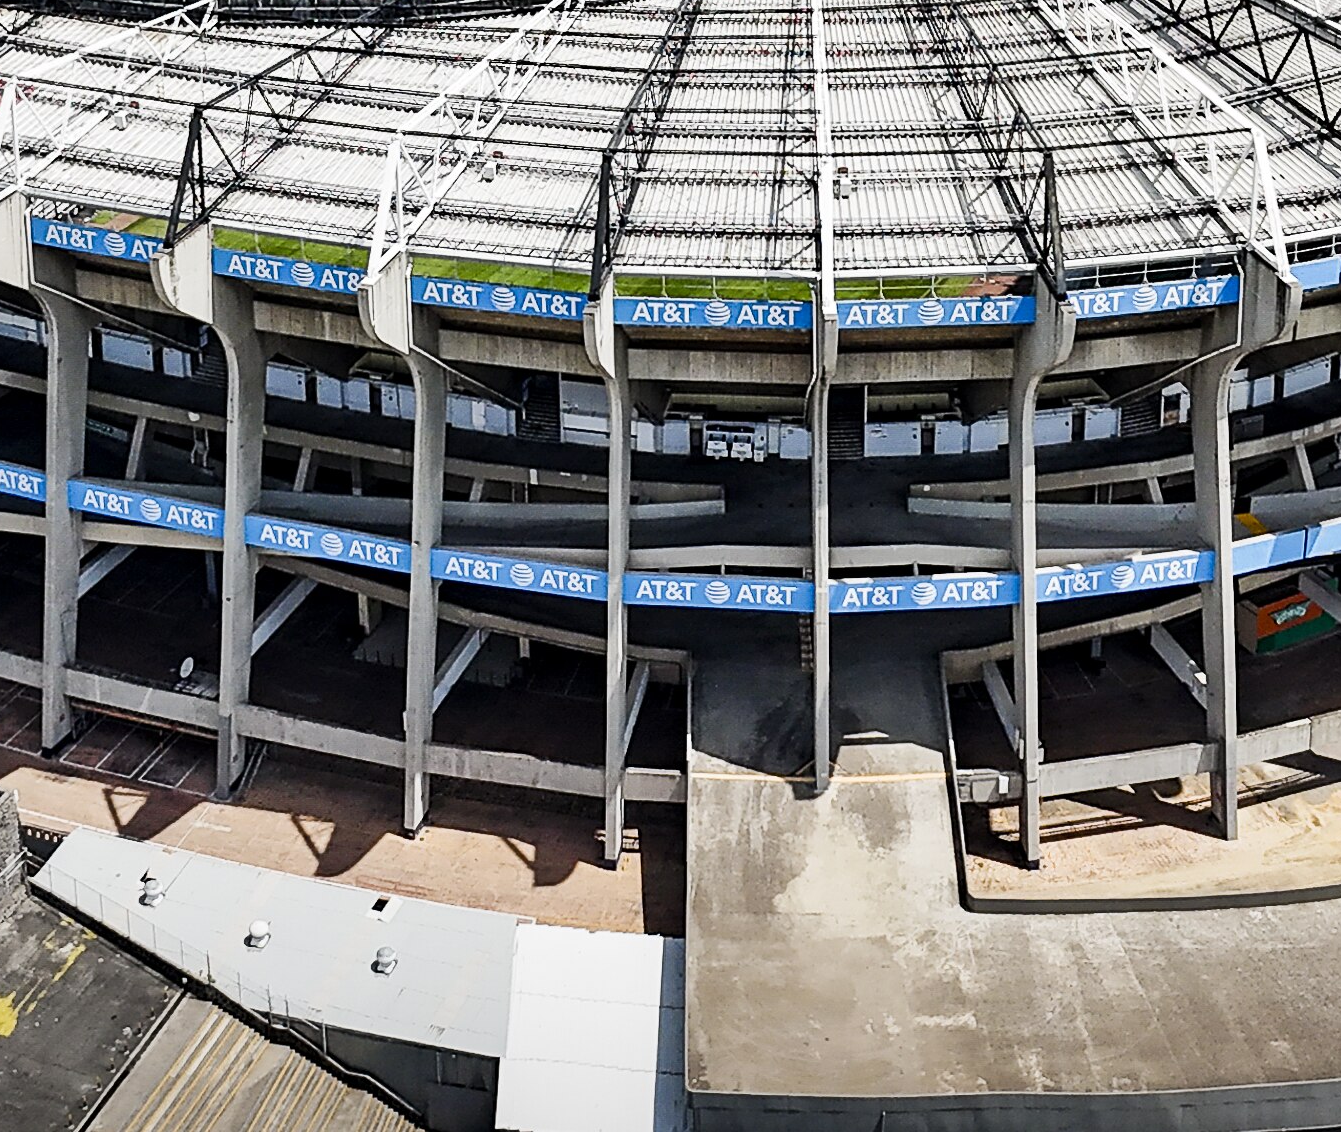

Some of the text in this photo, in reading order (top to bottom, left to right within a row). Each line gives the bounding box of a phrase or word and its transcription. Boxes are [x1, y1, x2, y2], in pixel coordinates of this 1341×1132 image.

[45, 224, 97, 250] AT&T
[228, 254, 362, 293] AT&T AT&
[423, 282, 582, 316] AT&T AT&T
[632, 302, 802, 327] AT&T AT&T
[845, 299, 1015, 325] AT&T AT&T
[1070, 281, 1224, 315] AT&T AT&T
[83, 489, 218, 530] AT&T AT&T
[260, 523, 402, 566] AT&T AT&T
[445, 556, 599, 593] AT&T AT&T
[1045, 557, 1198, 596] AT&T AT&T
[636, 580, 798, 605] AT&T AT&T
[842, 580, 1004, 607] AT&T AT&T
